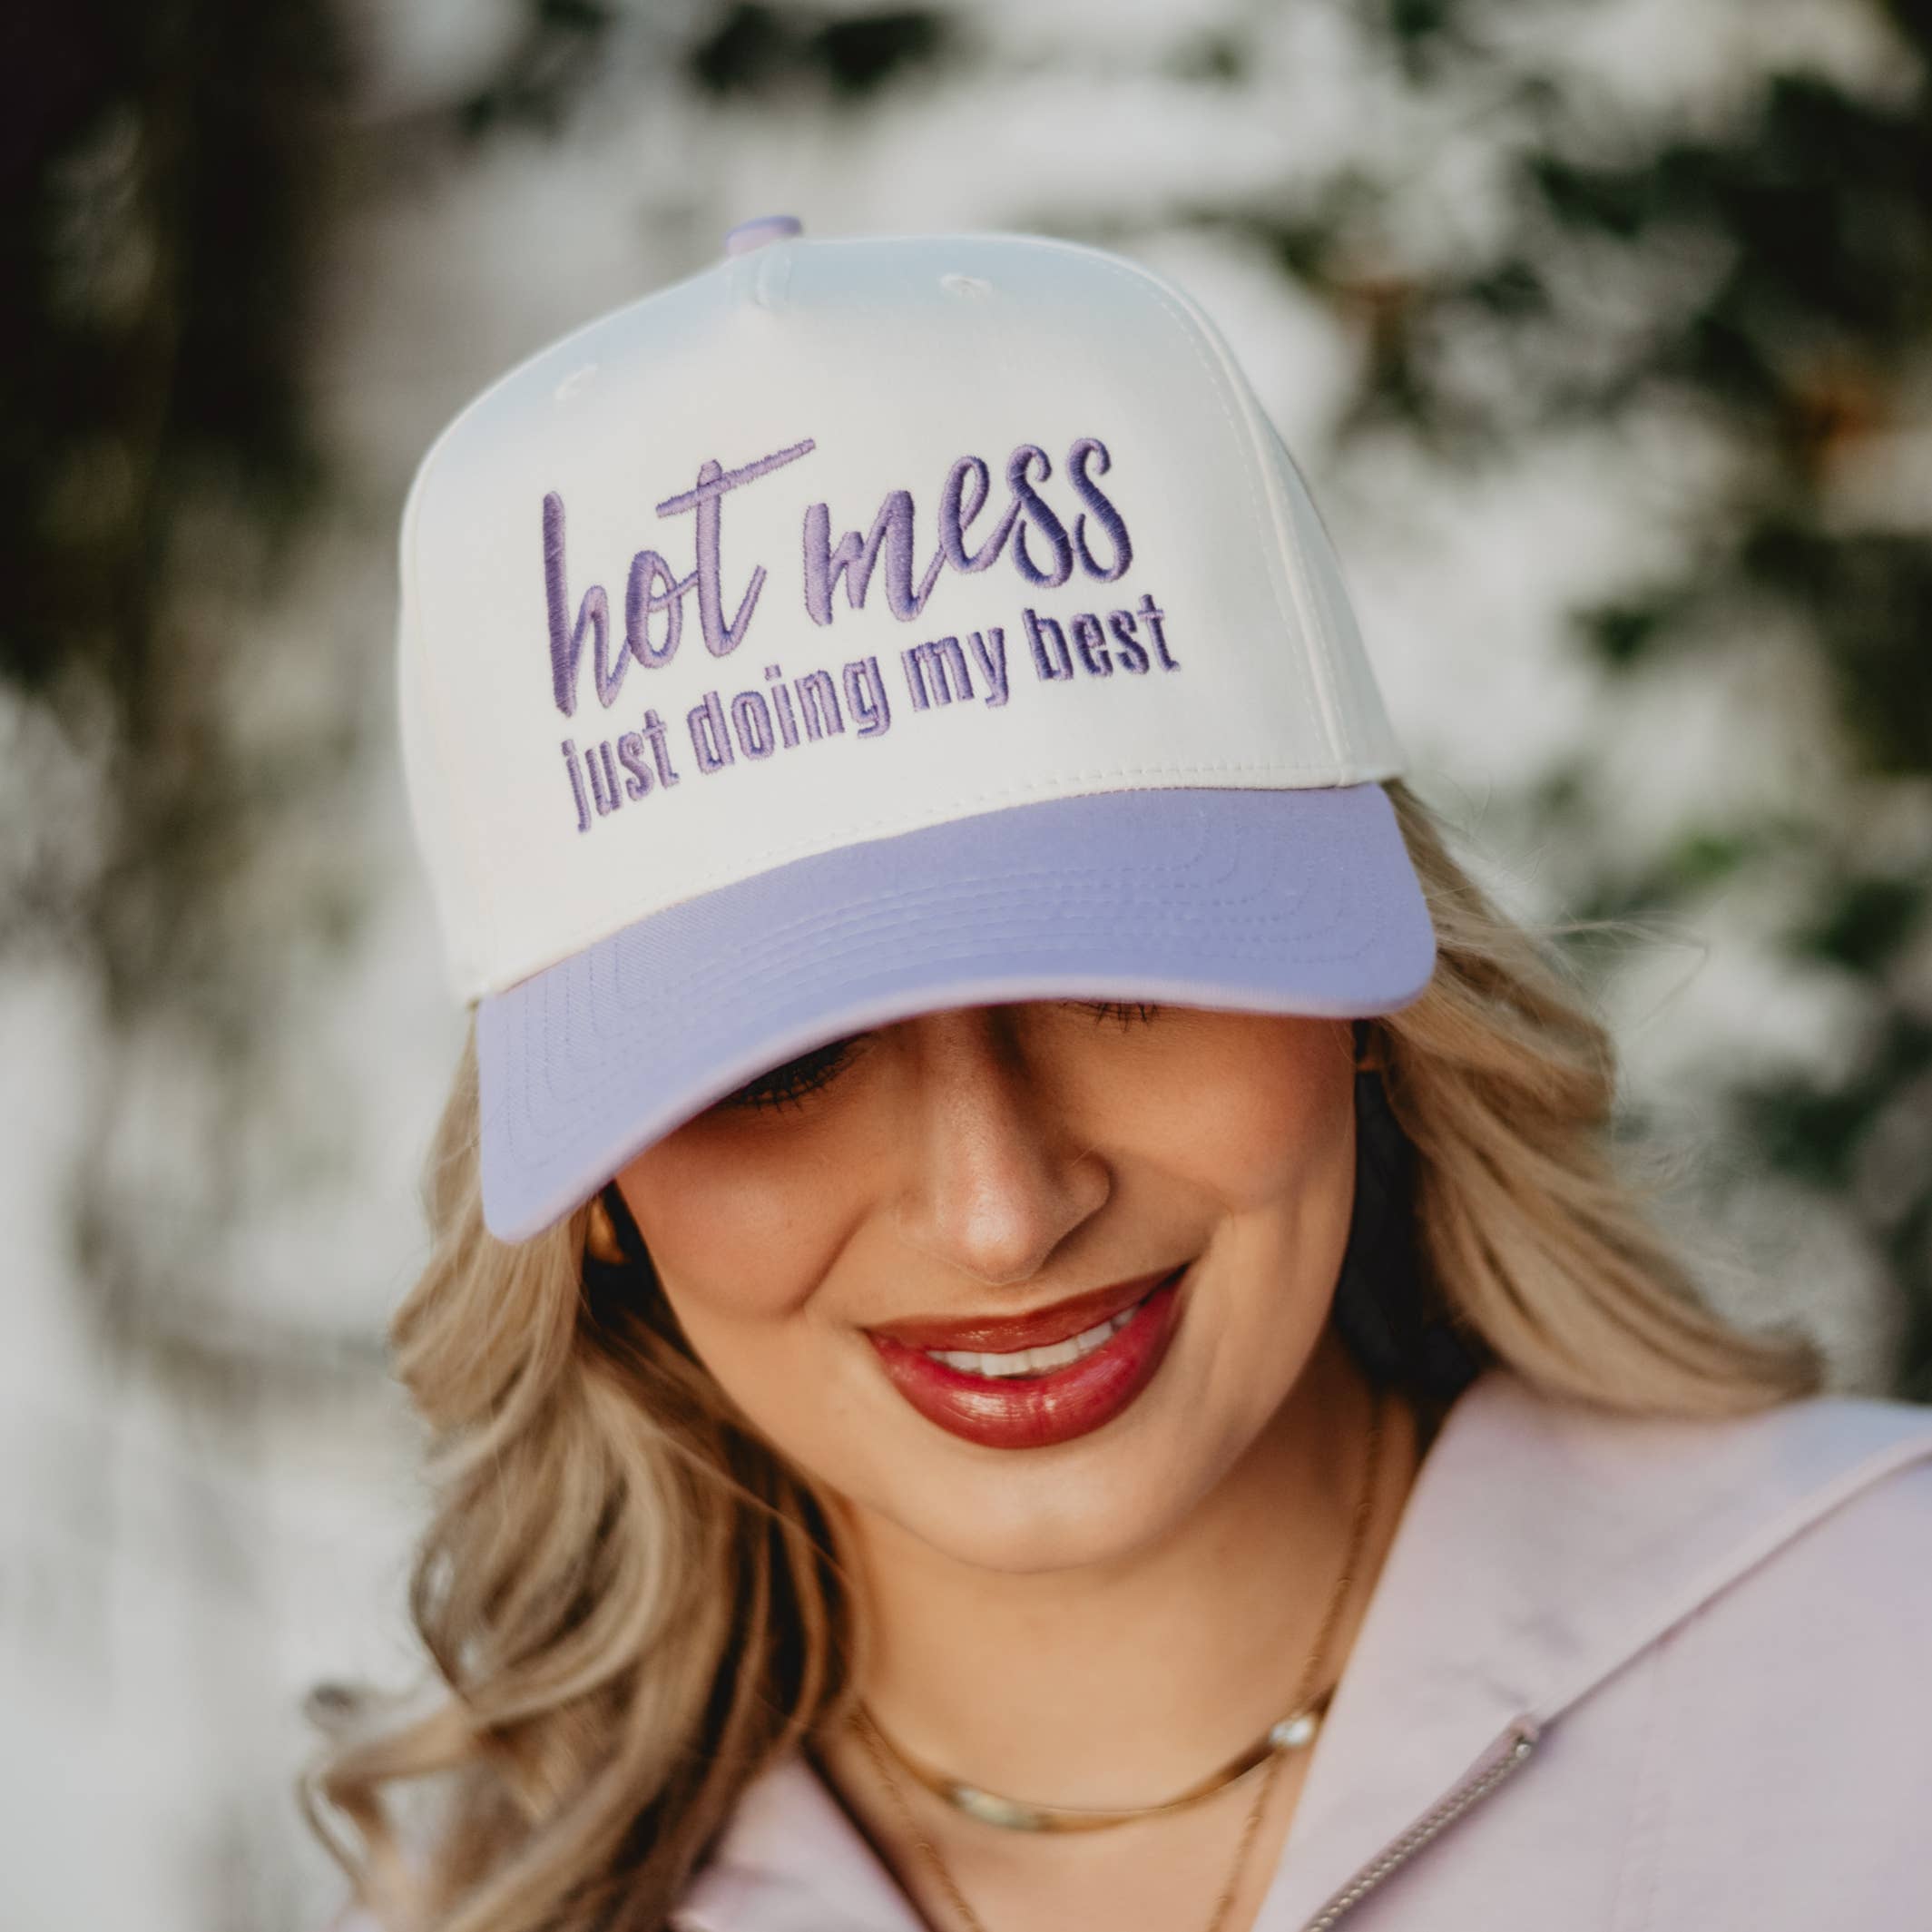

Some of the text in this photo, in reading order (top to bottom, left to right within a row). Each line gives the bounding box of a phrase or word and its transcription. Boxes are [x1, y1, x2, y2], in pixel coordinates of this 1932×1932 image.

[542, 436, 1133, 718] hot mess
[561, 593, 1181, 833] just doing my best
